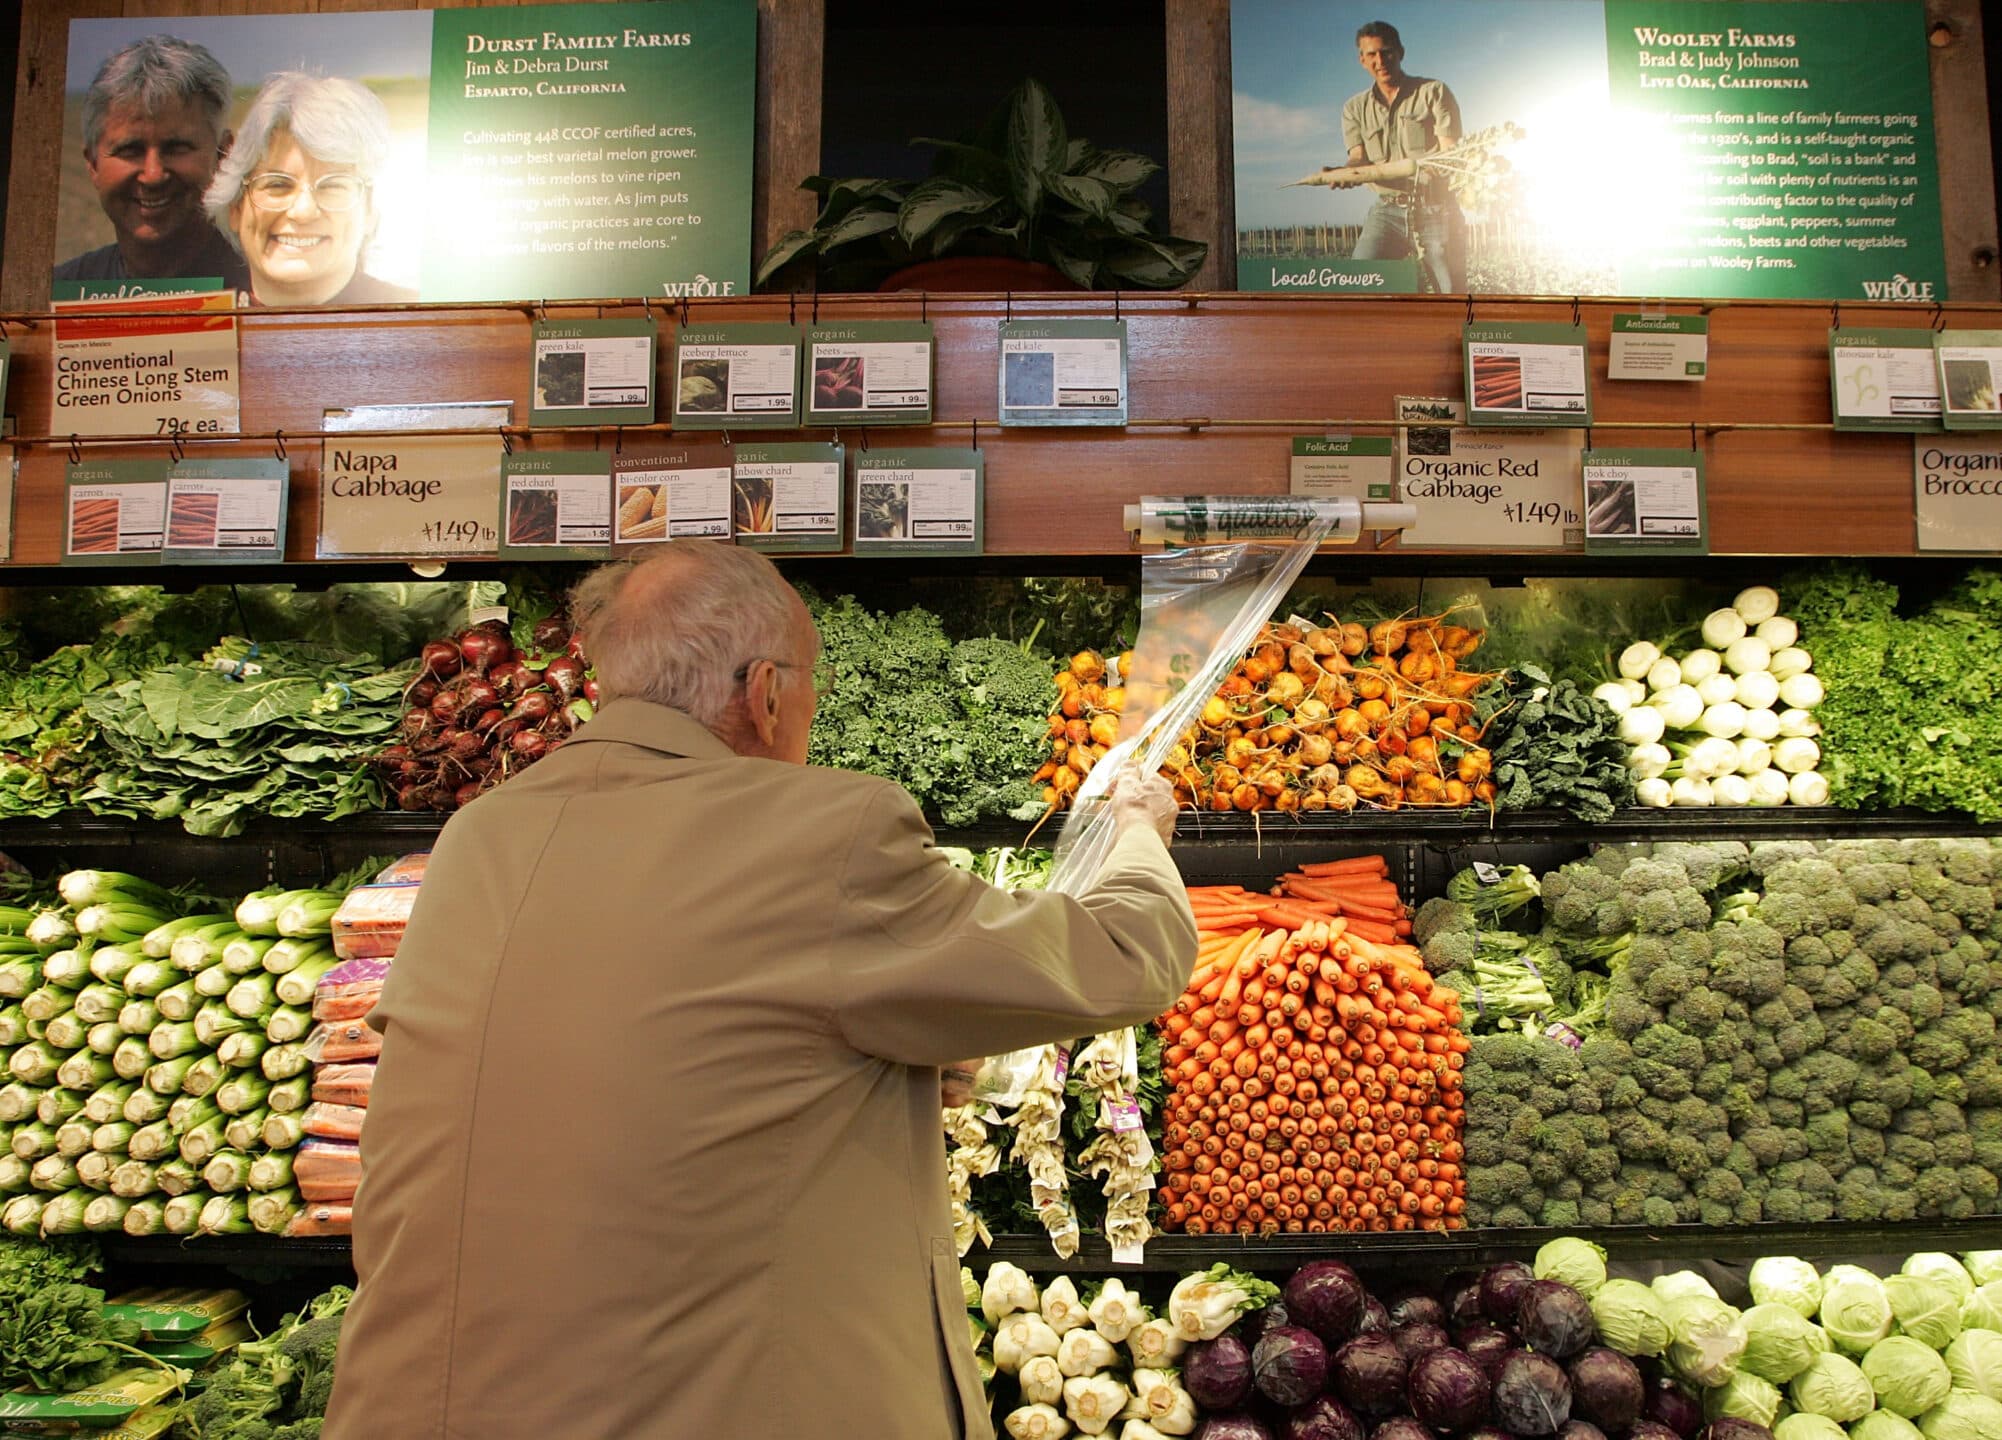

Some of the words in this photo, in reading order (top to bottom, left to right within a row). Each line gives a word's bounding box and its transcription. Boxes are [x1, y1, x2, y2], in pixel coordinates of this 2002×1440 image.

[466, 34, 537, 53] DURST
[542, 32, 618, 50] FAMILY
[623, 29, 691, 47] FARMS
[1634, 27, 1722, 47] WOOLEY
[1728, 28, 1795, 47] FARMS
[465, 60, 490, 79] Jim
[495, 59, 509, 74] &
[513, 57, 561, 74] Debra
[565, 56, 609, 72] Durst
[1639, 52, 1676, 68] Brad
[1679, 52, 1694, 68] &
[1698, 52, 1733, 70] Judy
[1738, 52, 1799, 70] Johnson
[1640, 74, 1674, 88] LIVE
[1677, 74, 1716, 90] OAK,
[1719, 75, 1808, 89] CALIFORNIA
[464, 84, 533, 98] ESPARTO,
[536, 81, 626, 95] CALIFORNIA
[1715, 111, 1745, 125] from
[1756, 112, 1779, 125] line
[1796, 112, 1832, 127] family
[1835, 112, 1881, 125] farmers
[1883, 113, 1917, 128] going
[463, 130, 531, 145] Cultivating
[535, 128, 558, 144] 448
[562, 127, 600, 141] CCOF
[604, 125, 656, 140] certified
[659, 126, 696, 138] acres,
[1711, 132, 1753, 148] 1920's,
[1756, 132, 1779, 145] and
[1804, 132, 1867, 148] self-taught
[1869, 133, 1914, 148] organic
[501, 154, 523, 165] our
[527, 150, 554, 164] best
[557, 148, 603, 162] varietal
[607, 149, 647, 161] melon
[651, 147, 697, 163] grower.
[1767, 153, 1798, 166] Brad,
[1893, 153, 1916, 165] and
[528, 172, 547, 186] his
[550, 173, 598, 185] melons
[618, 170, 645, 183] vine
[648, 171, 681, 186] ripen
[1726, 173, 1749, 186] soil
[1751, 173, 1777, 186] with
[1779, 174, 1815, 188] plenty
[1833, 174, 1887, 186] nutrients
[544, 193, 570, 207] with
[574, 193, 611, 206] water.
[634, 191, 656, 207] Jim
[660, 191, 688, 206] puts
[1784, 194, 1819, 207] factor
[1836, 194, 1857, 207] the
[1858, 194, 1898, 209] quality
[522, 215, 568, 233] organic
[572, 214, 628, 232] practices
[633, 217, 653, 228] are
[657, 215, 684, 226] core
[1732, 214, 1788, 231] eggplant,
[1791, 216, 1843, 231] peppers,
[1845, 217, 1896, 227] summer
[532, 238, 575, 253] flavors
[594, 237, 614, 250] the
[1698, 236, 1746, 250] melons,
[1749, 235, 1782, 248] beets
[1784, 235, 1807, 248] and
[1810, 236, 1842, 248] other
[1844, 236, 1908, 250] vegetables
[1709, 256, 1753, 271] Wooley
[1756, 256, 1797, 268] Farms.
[1272, 267, 1317, 287] Local
[1319, 268, 1384, 287] Growers
[662, 280, 735, 297] WHOLE
[1862, 281, 1934, 298] WHOLE
[1625, 320, 1680, 330] Antioxidants
[539, 328, 582, 338] organic
[682, 333, 726, 343] organic
[812, 328, 857, 340] organic
[1006, 328, 1050, 338] organic
[1469, 330, 1512, 341] organic
[539, 343, 565, 353] green
[566, 341, 585, 350] kale
[1006, 341, 1021, 350] red
[1023, 341, 1042, 350] kale
[1835, 335, 1877, 346] organic
[682, 348, 716, 359] iceberg
[718, 348, 749, 357] lettuce
[816, 346, 841, 355] beets
[1473, 346, 1504, 354] carrots
[1877, 350, 1895, 359] kale
[57, 350, 173, 372] Conventional
[57, 372, 129, 390] Chinese
[135, 371, 178, 389] Long
[183, 368, 229, 384] Stem
[57, 391, 110, 407] Green
[116, 387, 182, 404] Onions
[767, 398, 786, 407] 1.99
[900, 395, 919, 403] 1.99
[1092, 395, 1111, 403] 1.99
[157, 417, 190, 434] 79¢
[196, 419, 224, 432] ea.
[1306, 442, 1326, 451] Folic
[1328, 442, 1348, 451] Acid
[334, 451, 397, 474] Napa
[508, 461, 551, 472] organic
[615, 452, 688, 468] organic
[862, 457, 906, 468] organic
[1588, 457, 1632, 466] organic
[72, 471, 112, 480] organic
[765, 465, 792, 475] chard
[1406, 457, 1494, 480] Organic
[1498, 458, 1538, 477] Red
[1587, 468, 1605, 478] bok
[1607, 468, 1628, 480] choy
[511, 478, 527, 487] red
[529, 478, 555, 487] chard
[620, 474, 659, 483] bi-color
[661, 474, 680, 482] corn
[860, 472, 885, 482] green
[887, 471, 914, 481] chard
[74, 489, 103, 497] carrots
[174, 483, 204, 491] carrots
[332, 475, 442, 502] Cabbage
[1407, 479, 1503, 504] Cabbage
[1504, 502, 1561, 525] $1.49
[1564, 510, 1581, 524] lb.
[811, 517, 829, 525] 1.99
[948, 523, 966, 531] 1.99
[592, 530, 610, 538] 1.99
